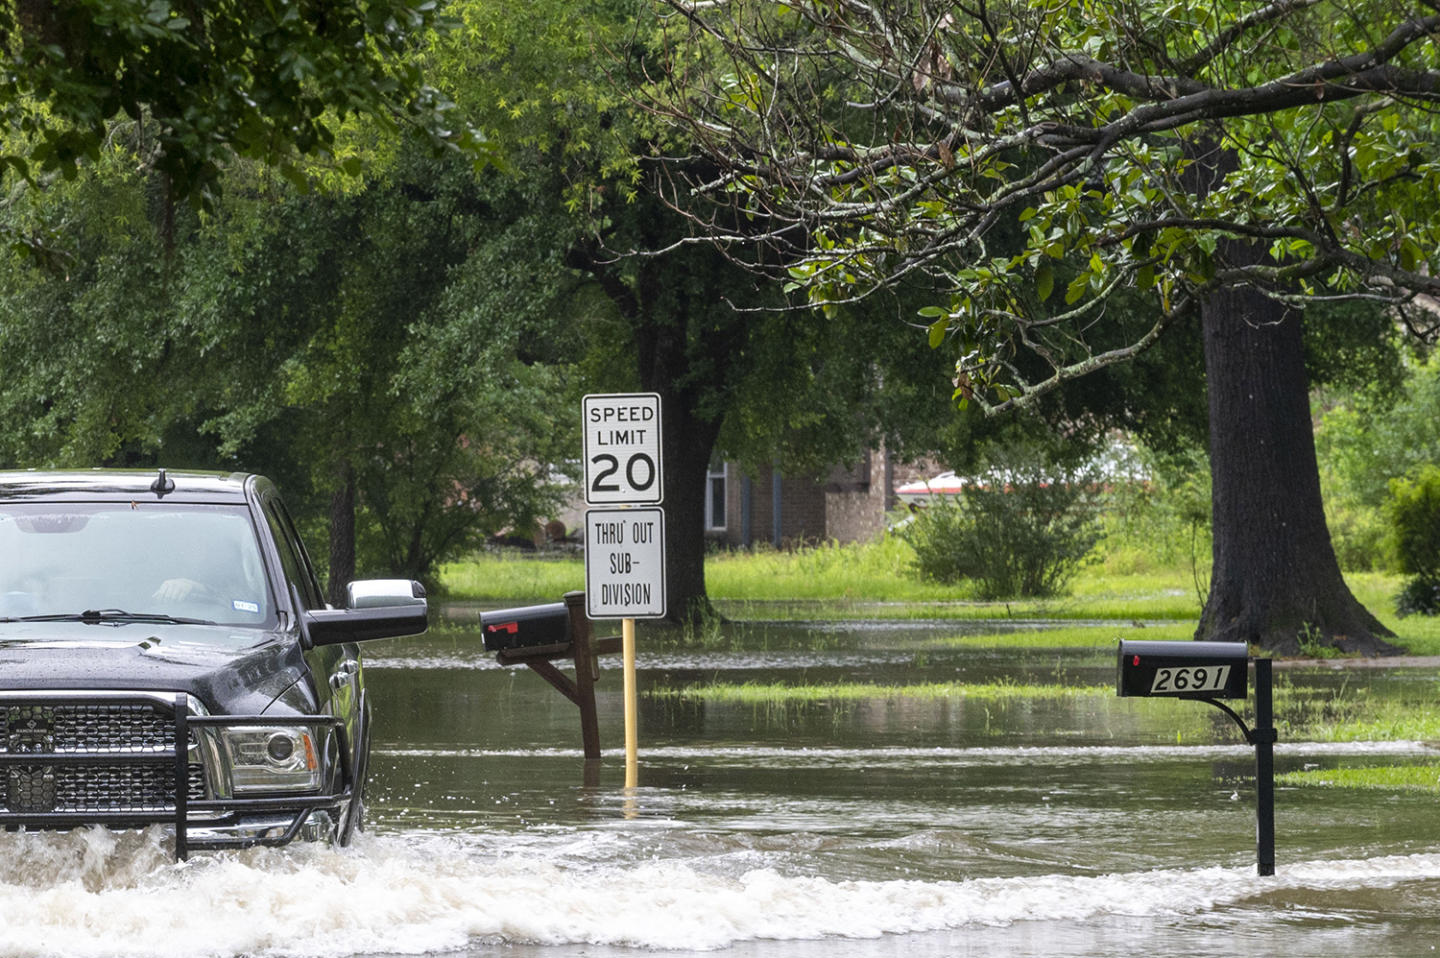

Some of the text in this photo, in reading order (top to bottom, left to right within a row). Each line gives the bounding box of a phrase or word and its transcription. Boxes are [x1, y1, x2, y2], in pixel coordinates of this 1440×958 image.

[590, 406, 654, 422] SPEED
[598, 429, 647, 446] LIMIT
[591, 452, 656, 492] 20
[595, 521, 654, 544] THRU OUT
[609, 552, 640, 575] SUB-
[601, 583, 651, 606] DIVISION
[1154, 667, 1224, 691] 2691
